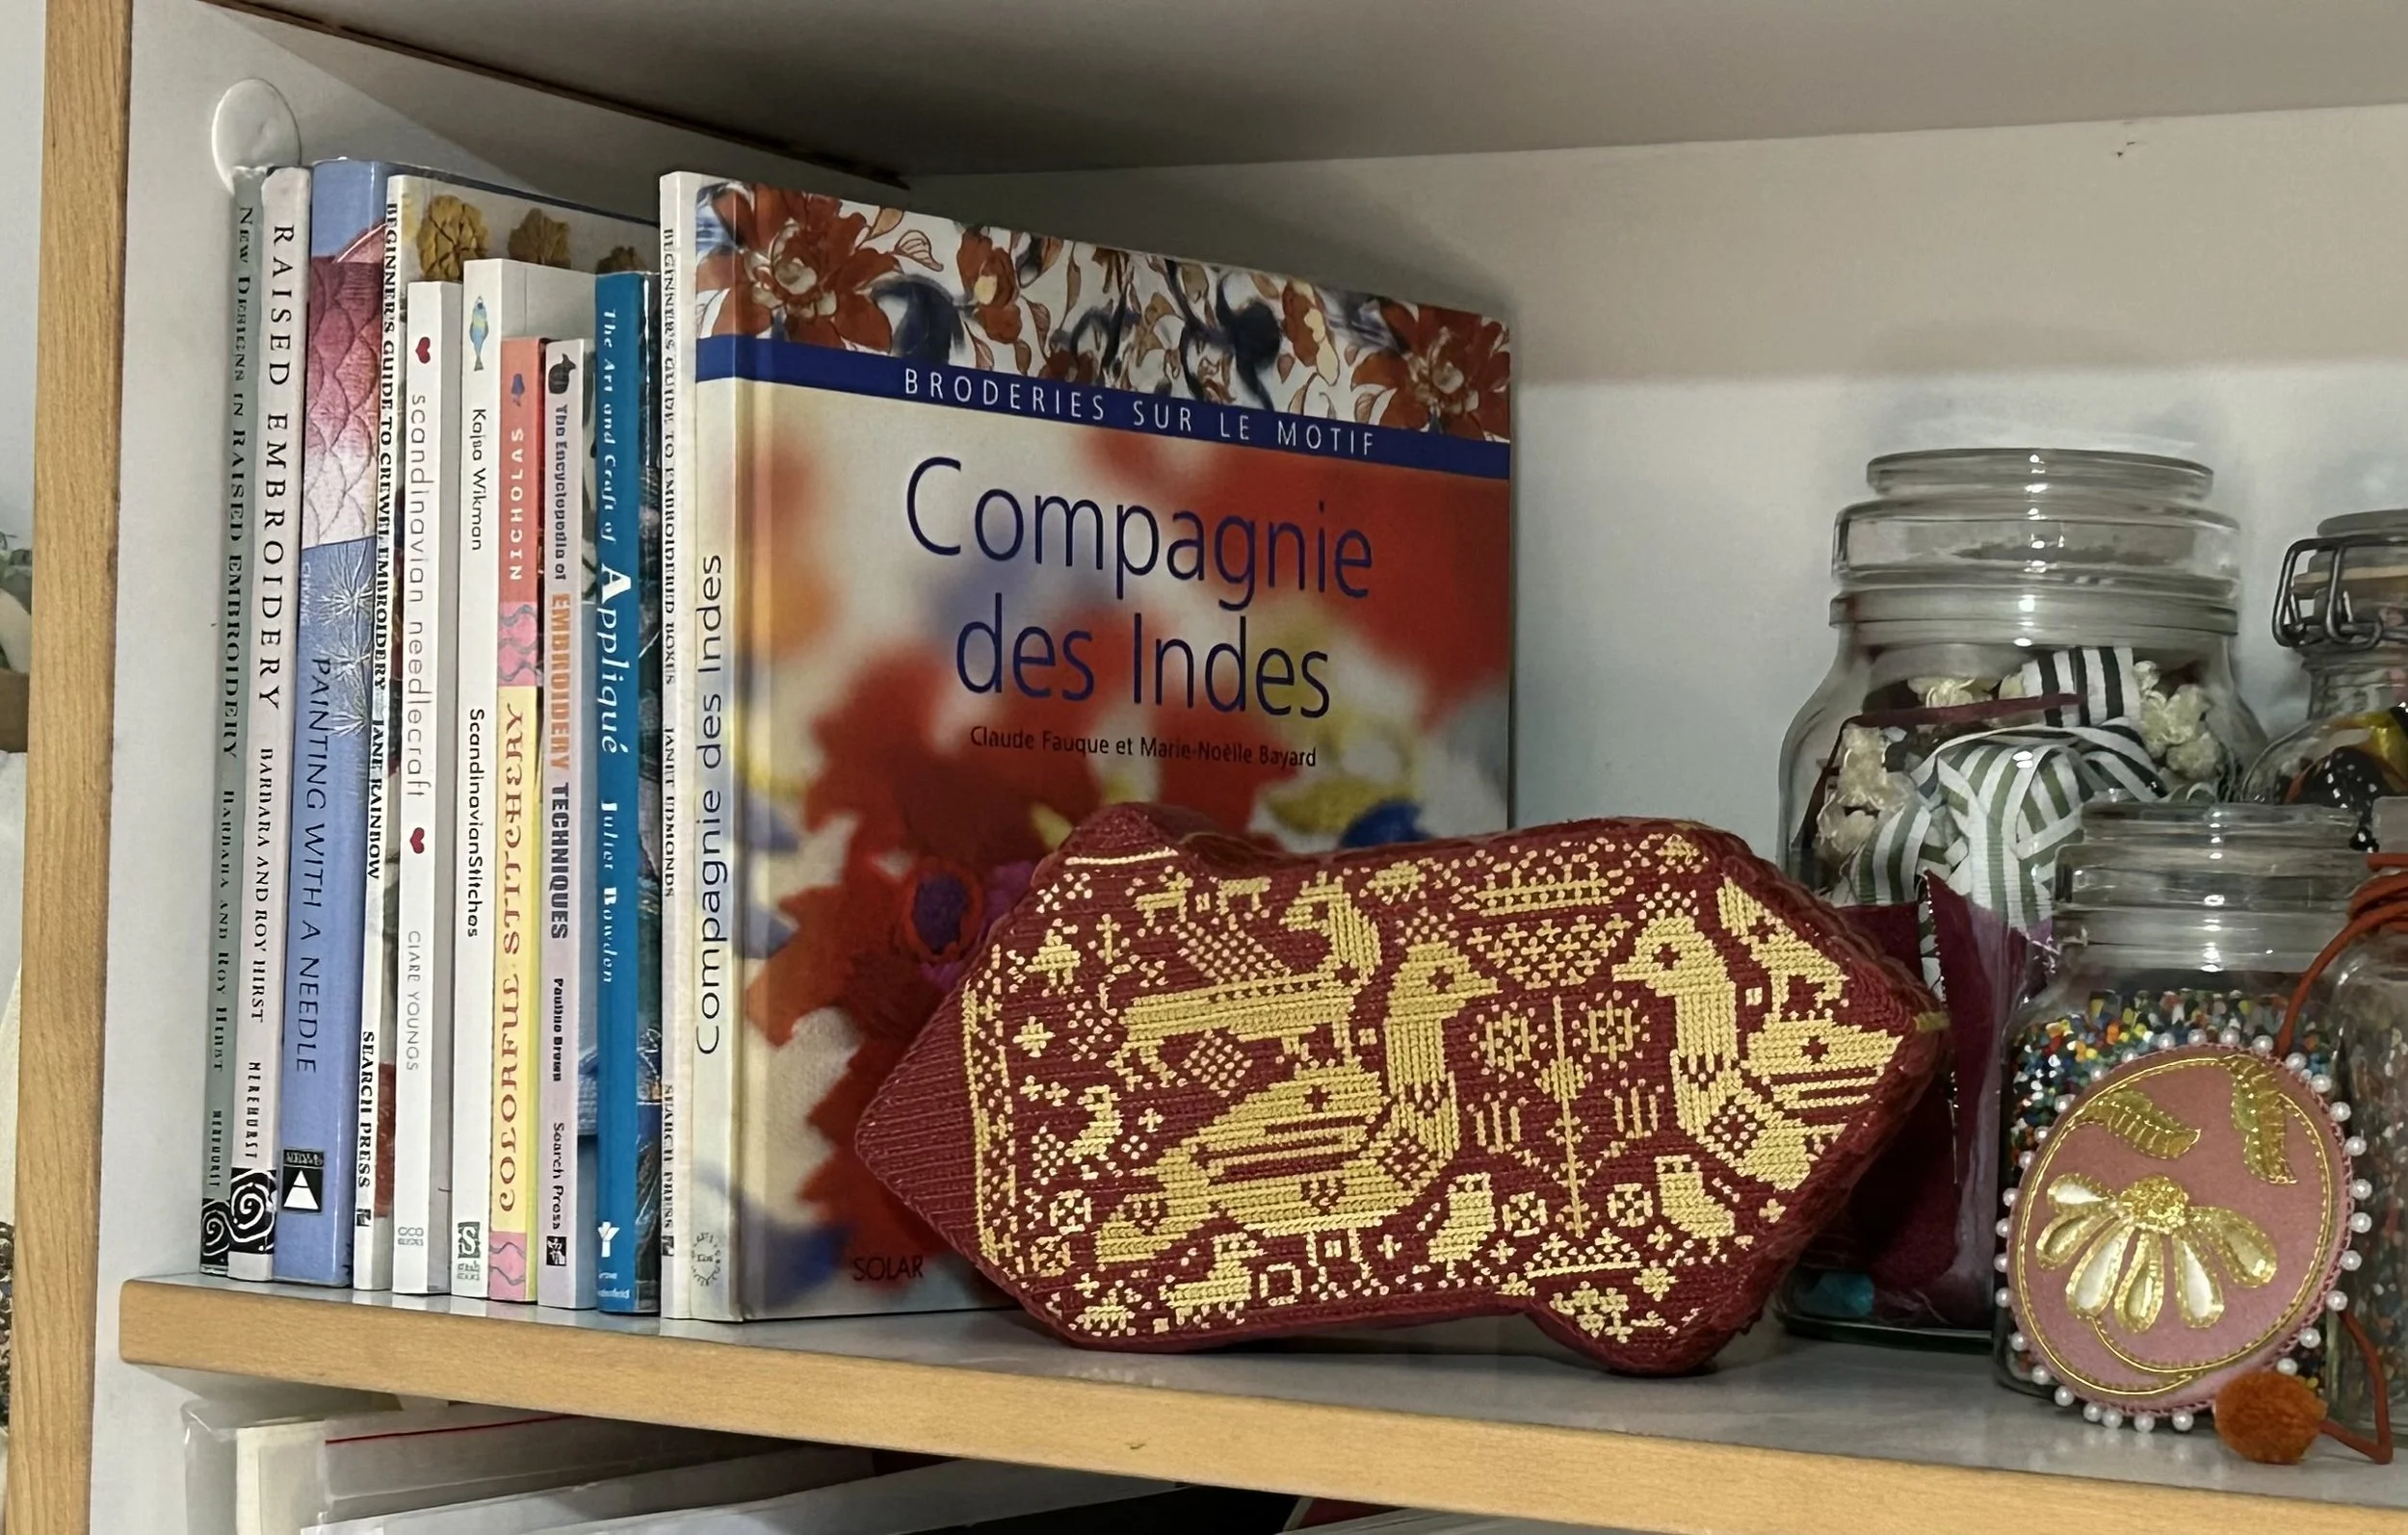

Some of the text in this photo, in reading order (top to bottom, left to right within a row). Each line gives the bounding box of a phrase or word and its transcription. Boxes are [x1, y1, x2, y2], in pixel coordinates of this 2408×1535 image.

[380, 416, 393, 446] TO
[381, 340, 395, 410] GUIDE
[664, 358, 675, 426] GUIDE
[664, 430, 675, 458] TO
[904, 368, 1375, 455] BRODERIES SUR LE MOTIF
[258, 224, 295, 709] RAISED EMBROIDERY
[377, 452, 391, 544] CREWEL
[470, 408, 486, 551] Kajsa Wikman
[509, 428, 524, 581] NICHOLAS
[596, 309, 632, 754] The Art and Craft of Appliqué
[905, 456, 1374, 611] Compagnie
[222, 555, 243, 758] EMBROIDERY
[375, 547, 390, 691] EMBROIDERY
[406, 395, 434, 796] scandinavian needlecraft
[955, 593, 1331, 718] des Indes
[549, 403, 570, 940] The Encyclopedia of EMBROIDERY TECHNIQUES
[367, 720, 384, 880] JANE RAINBOW
[695, 555, 728, 1054] Compagnie des Indes
[970, 725, 1035, 750] Claude
[1042, 730, 1110, 755] Fauque
[1115, 738, 1134, 756] et
[1259, 744, 1317, 769] Bayard
[250, 748, 274, 1023] BARBARA AND ROY HIRST
[296, 658, 330, 1074] PAINTING WITH A NEEDLE
[498, 702, 524, 1212] COLORFUL STITCHERY
[406, 991, 420, 1071] YOUNGS
[552, 1035, 563, 1082] Brown
[356, 1030, 376, 1188] SEARCH PRESS
[552, 1122, 565, 1231] Search Press
[852, 1255, 924, 1281] SOLAR
